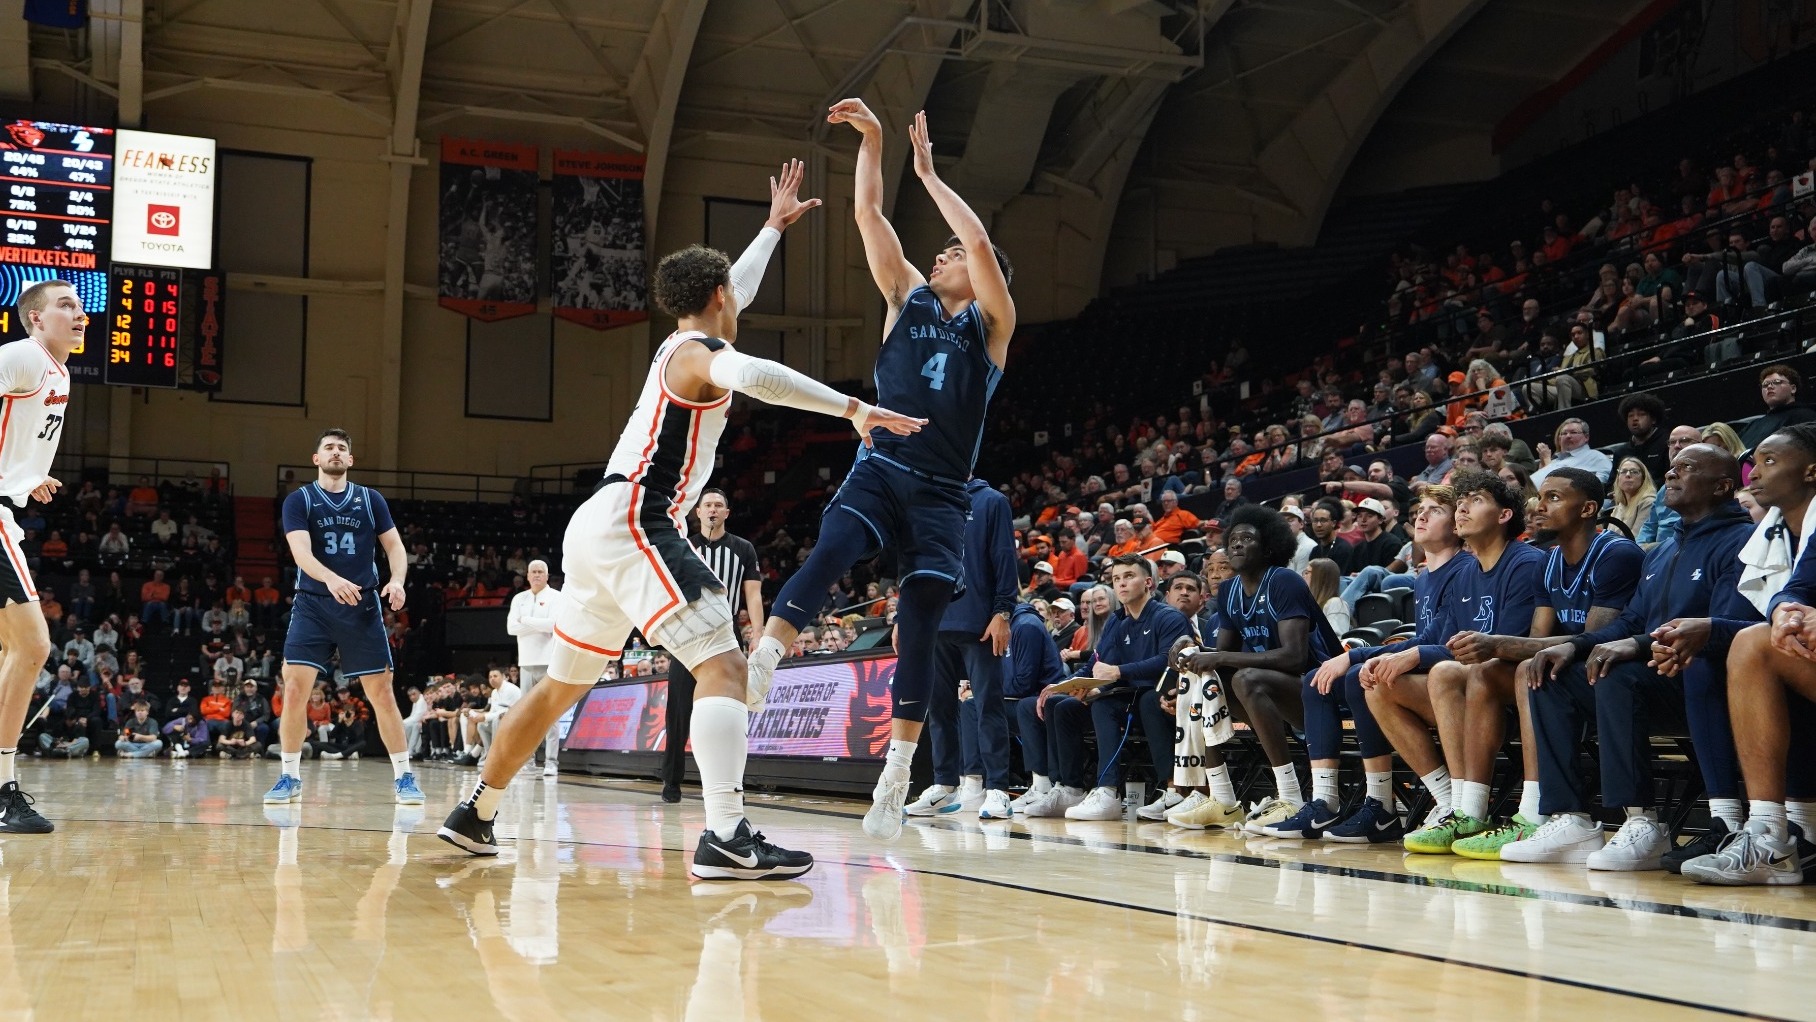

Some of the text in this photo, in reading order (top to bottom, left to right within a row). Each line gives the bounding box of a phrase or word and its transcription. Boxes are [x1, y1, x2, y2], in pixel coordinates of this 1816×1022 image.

[122, 149, 210, 174] FEARLESS
[484, 150, 518, 161] GREEN
[9, 165, 39, 178] 44%
[558, 160, 644, 172] STEVE JOHNSON
[68, 171, 96, 183] 47%
[68, 190, 94, 203] 2/4
[62, 223, 97, 236] 11/24
[141, 241, 184, 253] TOYOTA
[114, 267, 176, 280] PLYR FLS PTS
[122, 279, 178, 297] 2 0 4
[121, 298, 177, 315] 4 0 15
[116, 314, 176, 332] 12 1 0
[201, 276, 219, 366] STATE
[111, 331, 176, 349] 30 1 11
[910, 324, 970, 353] SAN DIEGO
[110, 348, 175, 367] 34 1 6
[84, 366, 99, 376] FLS
[920, 352, 949, 391] 4
[37, 413, 63, 441] 37
[317, 515, 361, 529] SAN DIEGO
[324, 531, 356, 555] 34
[773, 685, 802, 703] CRAFT
[799, 683, 825, 702] BEER
[822, 682, 839, 701] OF
[753, 708, 830, 738] ATHLETICS
